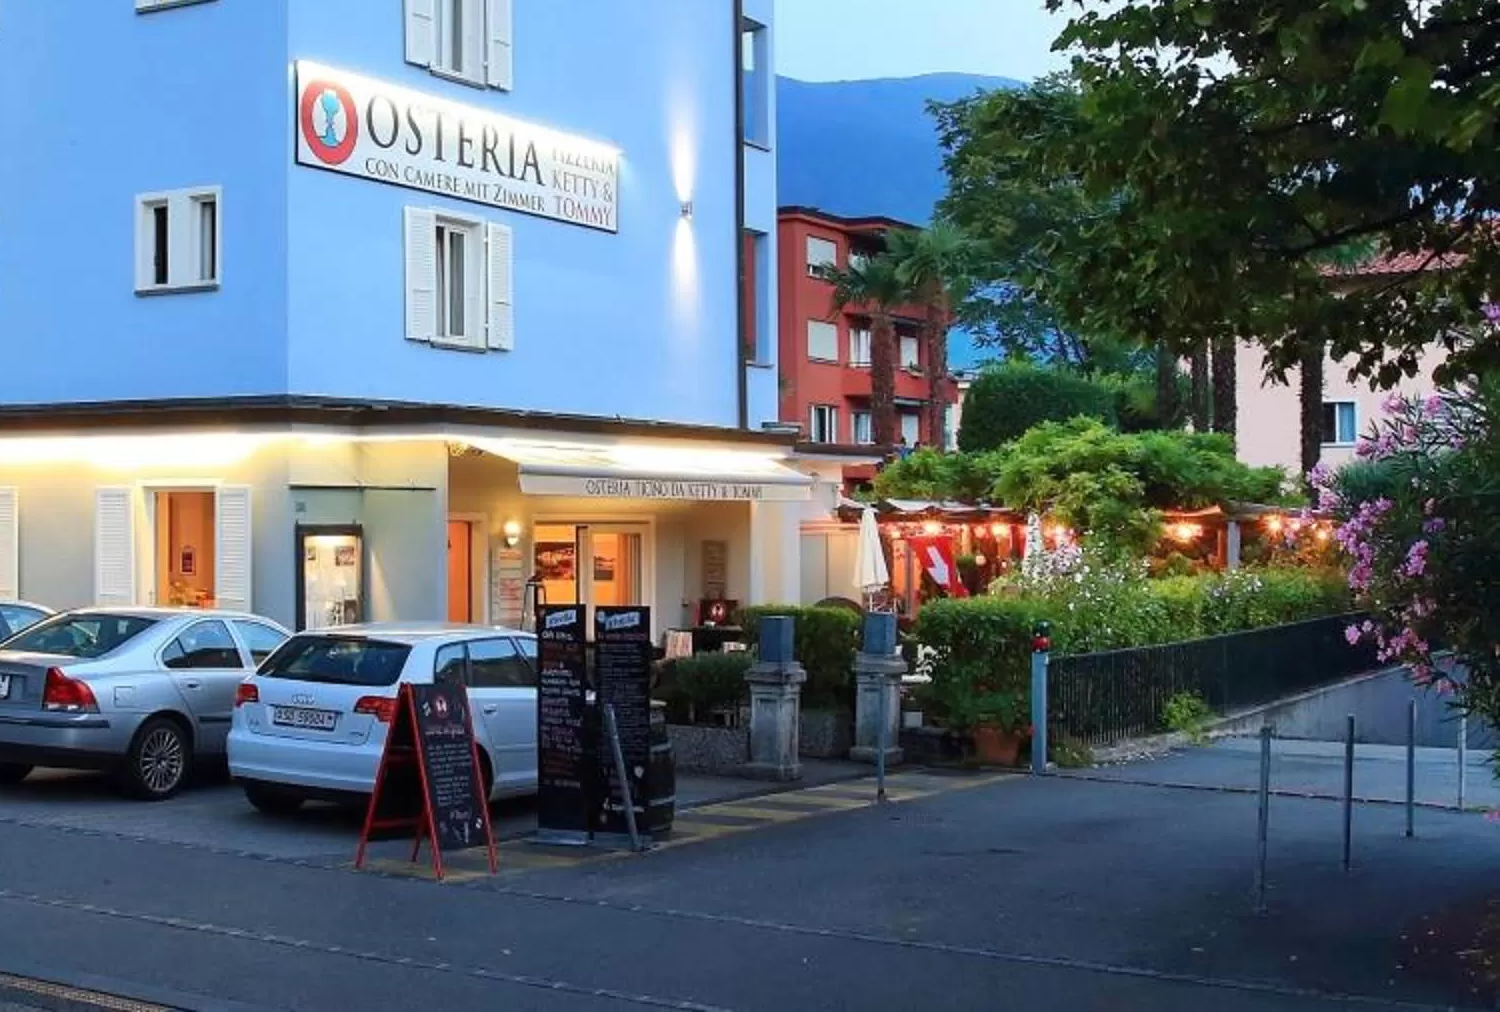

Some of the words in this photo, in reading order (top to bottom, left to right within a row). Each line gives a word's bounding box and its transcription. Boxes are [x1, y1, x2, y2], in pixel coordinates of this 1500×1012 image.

[365, 93, 547, 187] OSTERIA
[365, 157, 399, 180] CON
[403, 165, 461, 194] CAMERE
[493, 183, 546, 212] ZIMMER
[552, 169, 599, 199] KETTY
[603, 182, 613, 203] &
[553, 195, 612, 227] TOMMY
